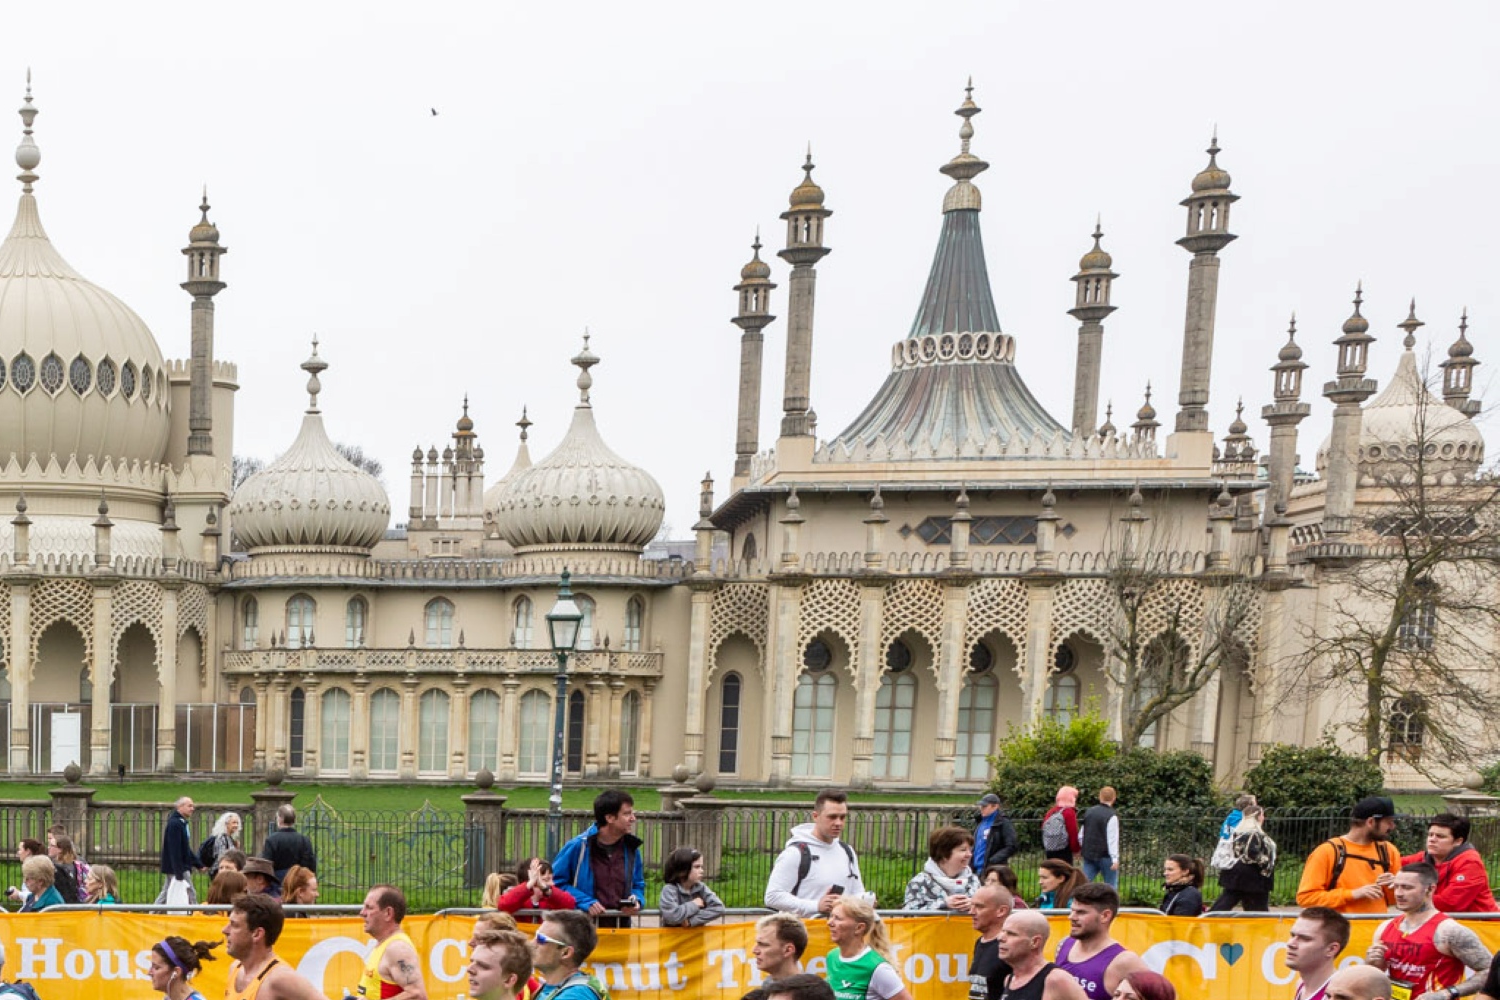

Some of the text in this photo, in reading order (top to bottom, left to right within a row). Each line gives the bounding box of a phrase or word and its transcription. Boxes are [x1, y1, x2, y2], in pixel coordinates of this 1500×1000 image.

[14, 937, 152, 981] Hous
[429, 938, 827, 991] Cnut Tr
